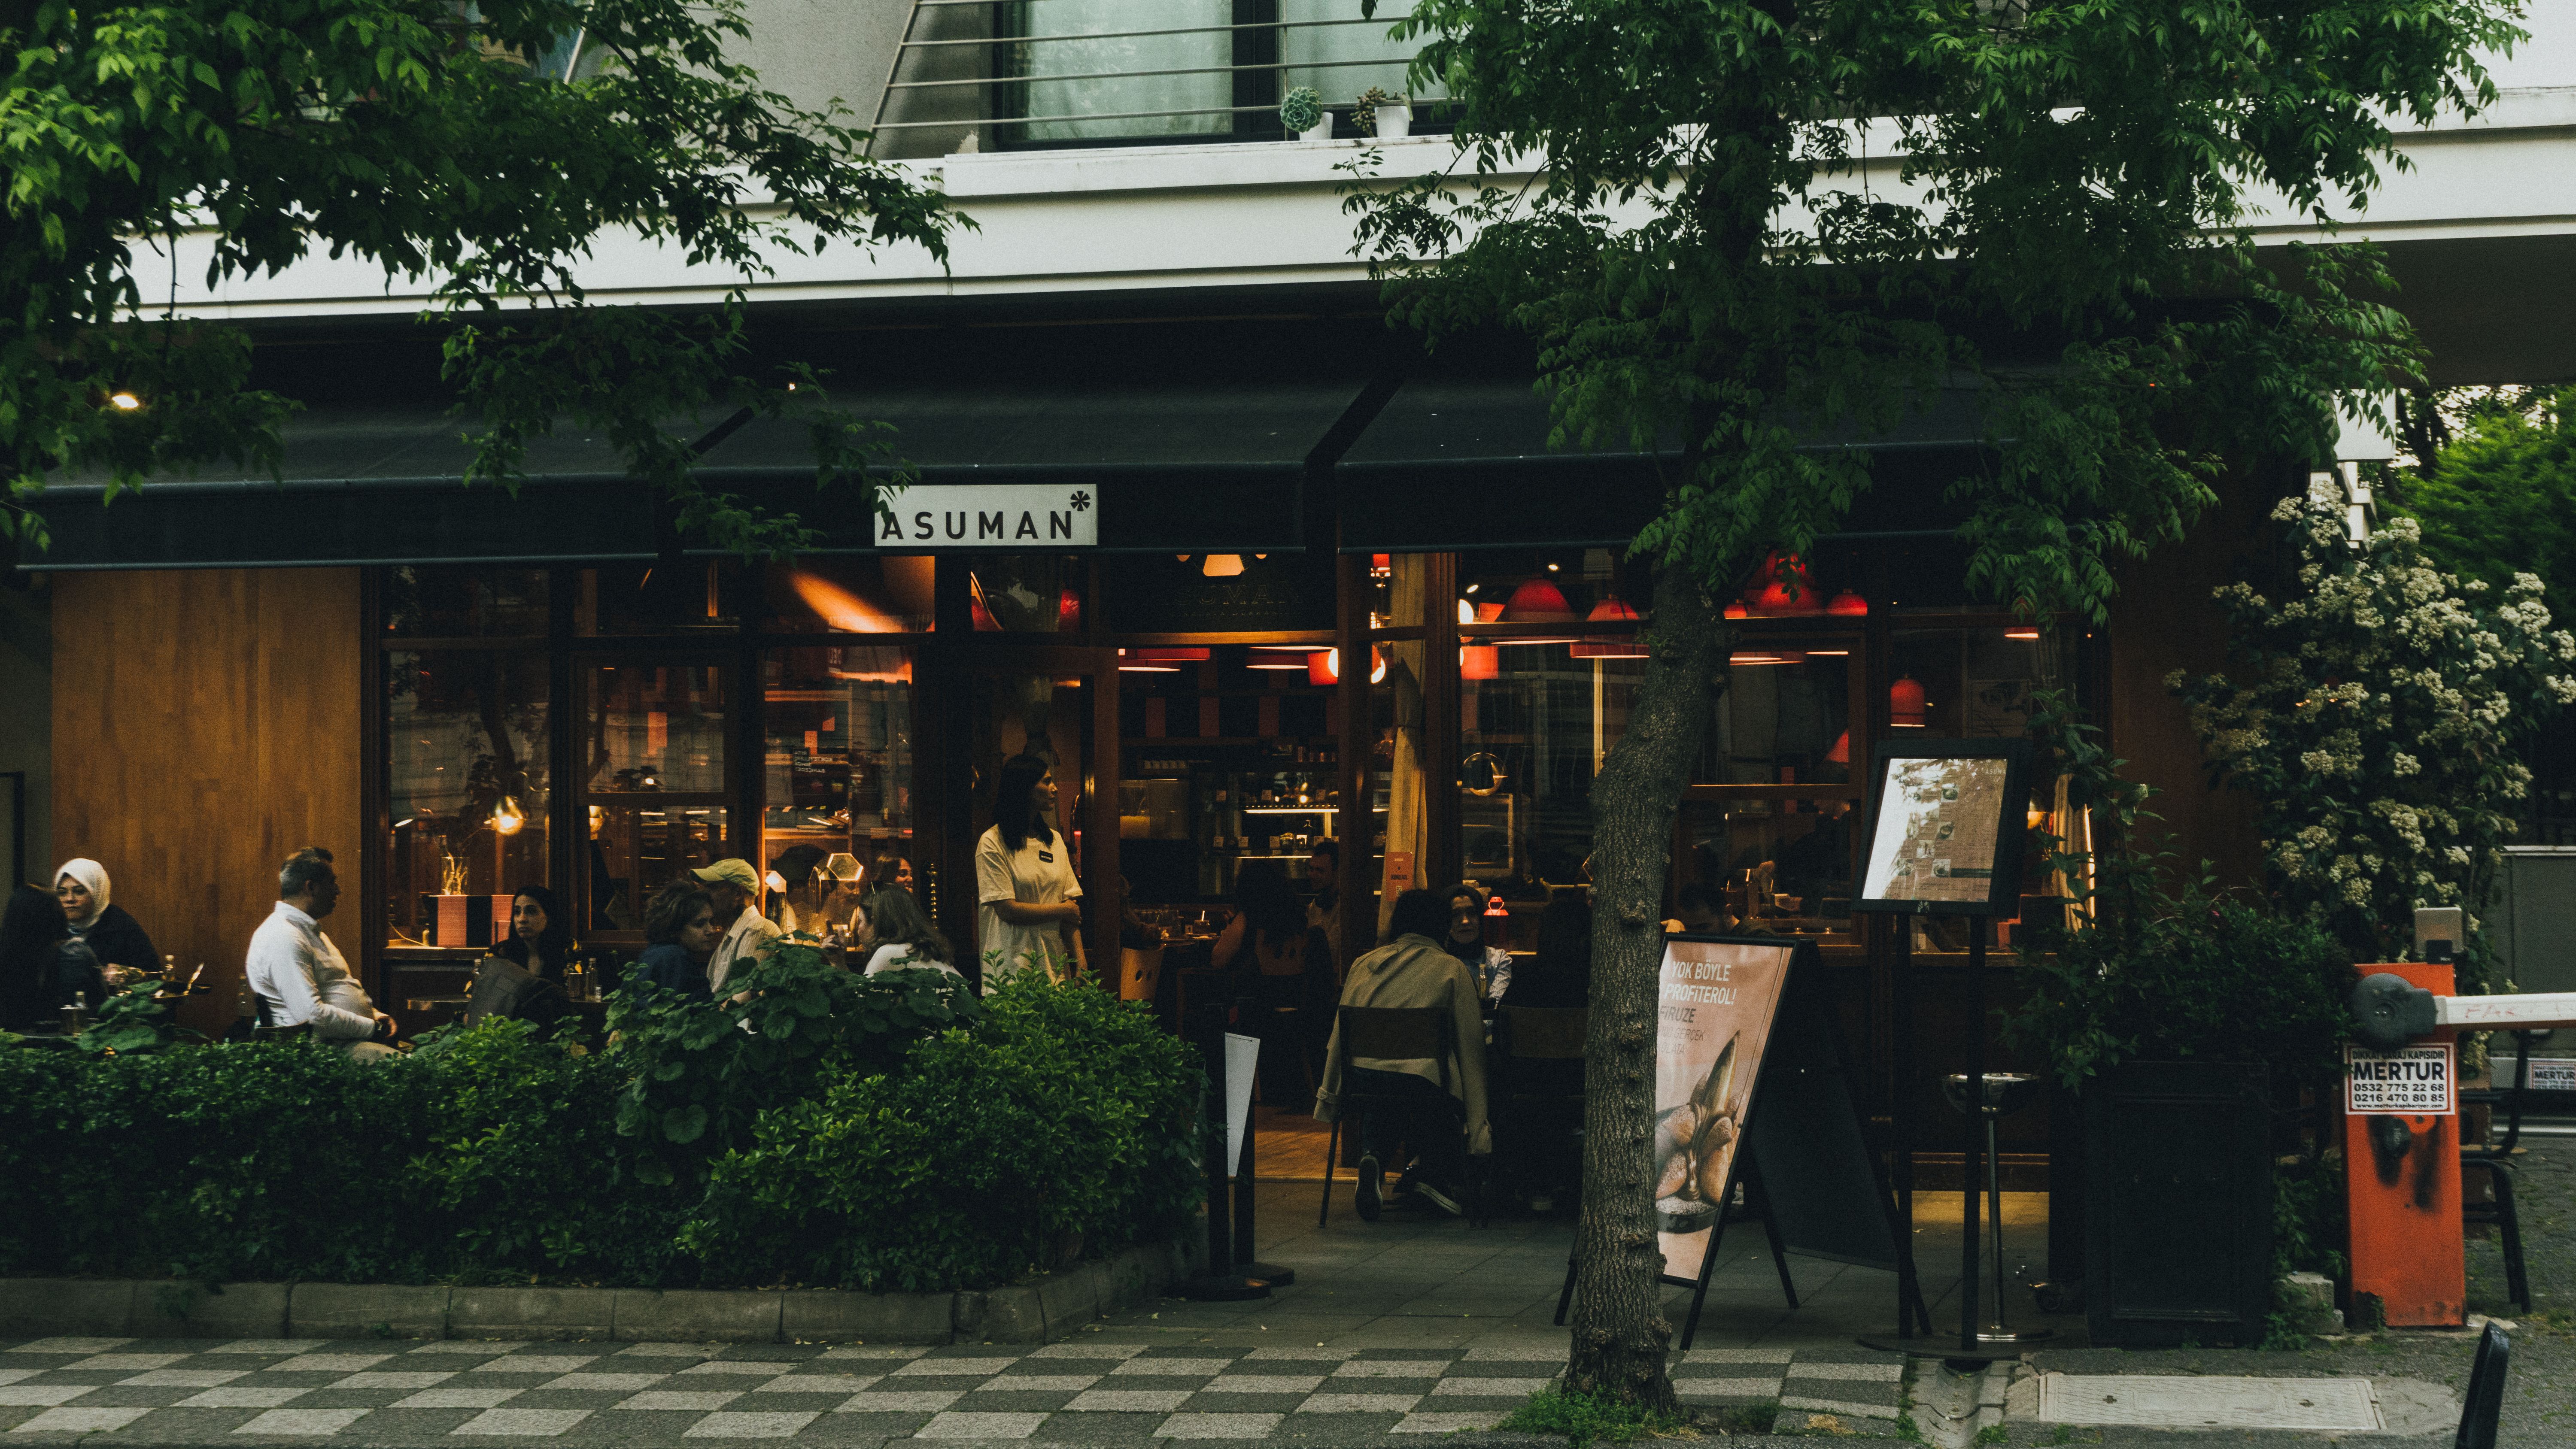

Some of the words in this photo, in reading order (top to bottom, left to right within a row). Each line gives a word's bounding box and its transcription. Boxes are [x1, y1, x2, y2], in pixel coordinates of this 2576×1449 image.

[881, 510, 1072, 540] ASUMAN
[1672, 961, 1694, 979] YOK
[1695, 960, 1732, 982] BÖYLE
[2354, 1062, 2444, 1080] MERTUR
[2534, 1071, 2575, 1079] MERTUR
[2354, 1083, 2383, 1091] 0532
[2387, 1083, 2408, 1091] 775
[2413, 1083, 2426, 1091] 22
[2430, 1083, 2444, 1091] 68
